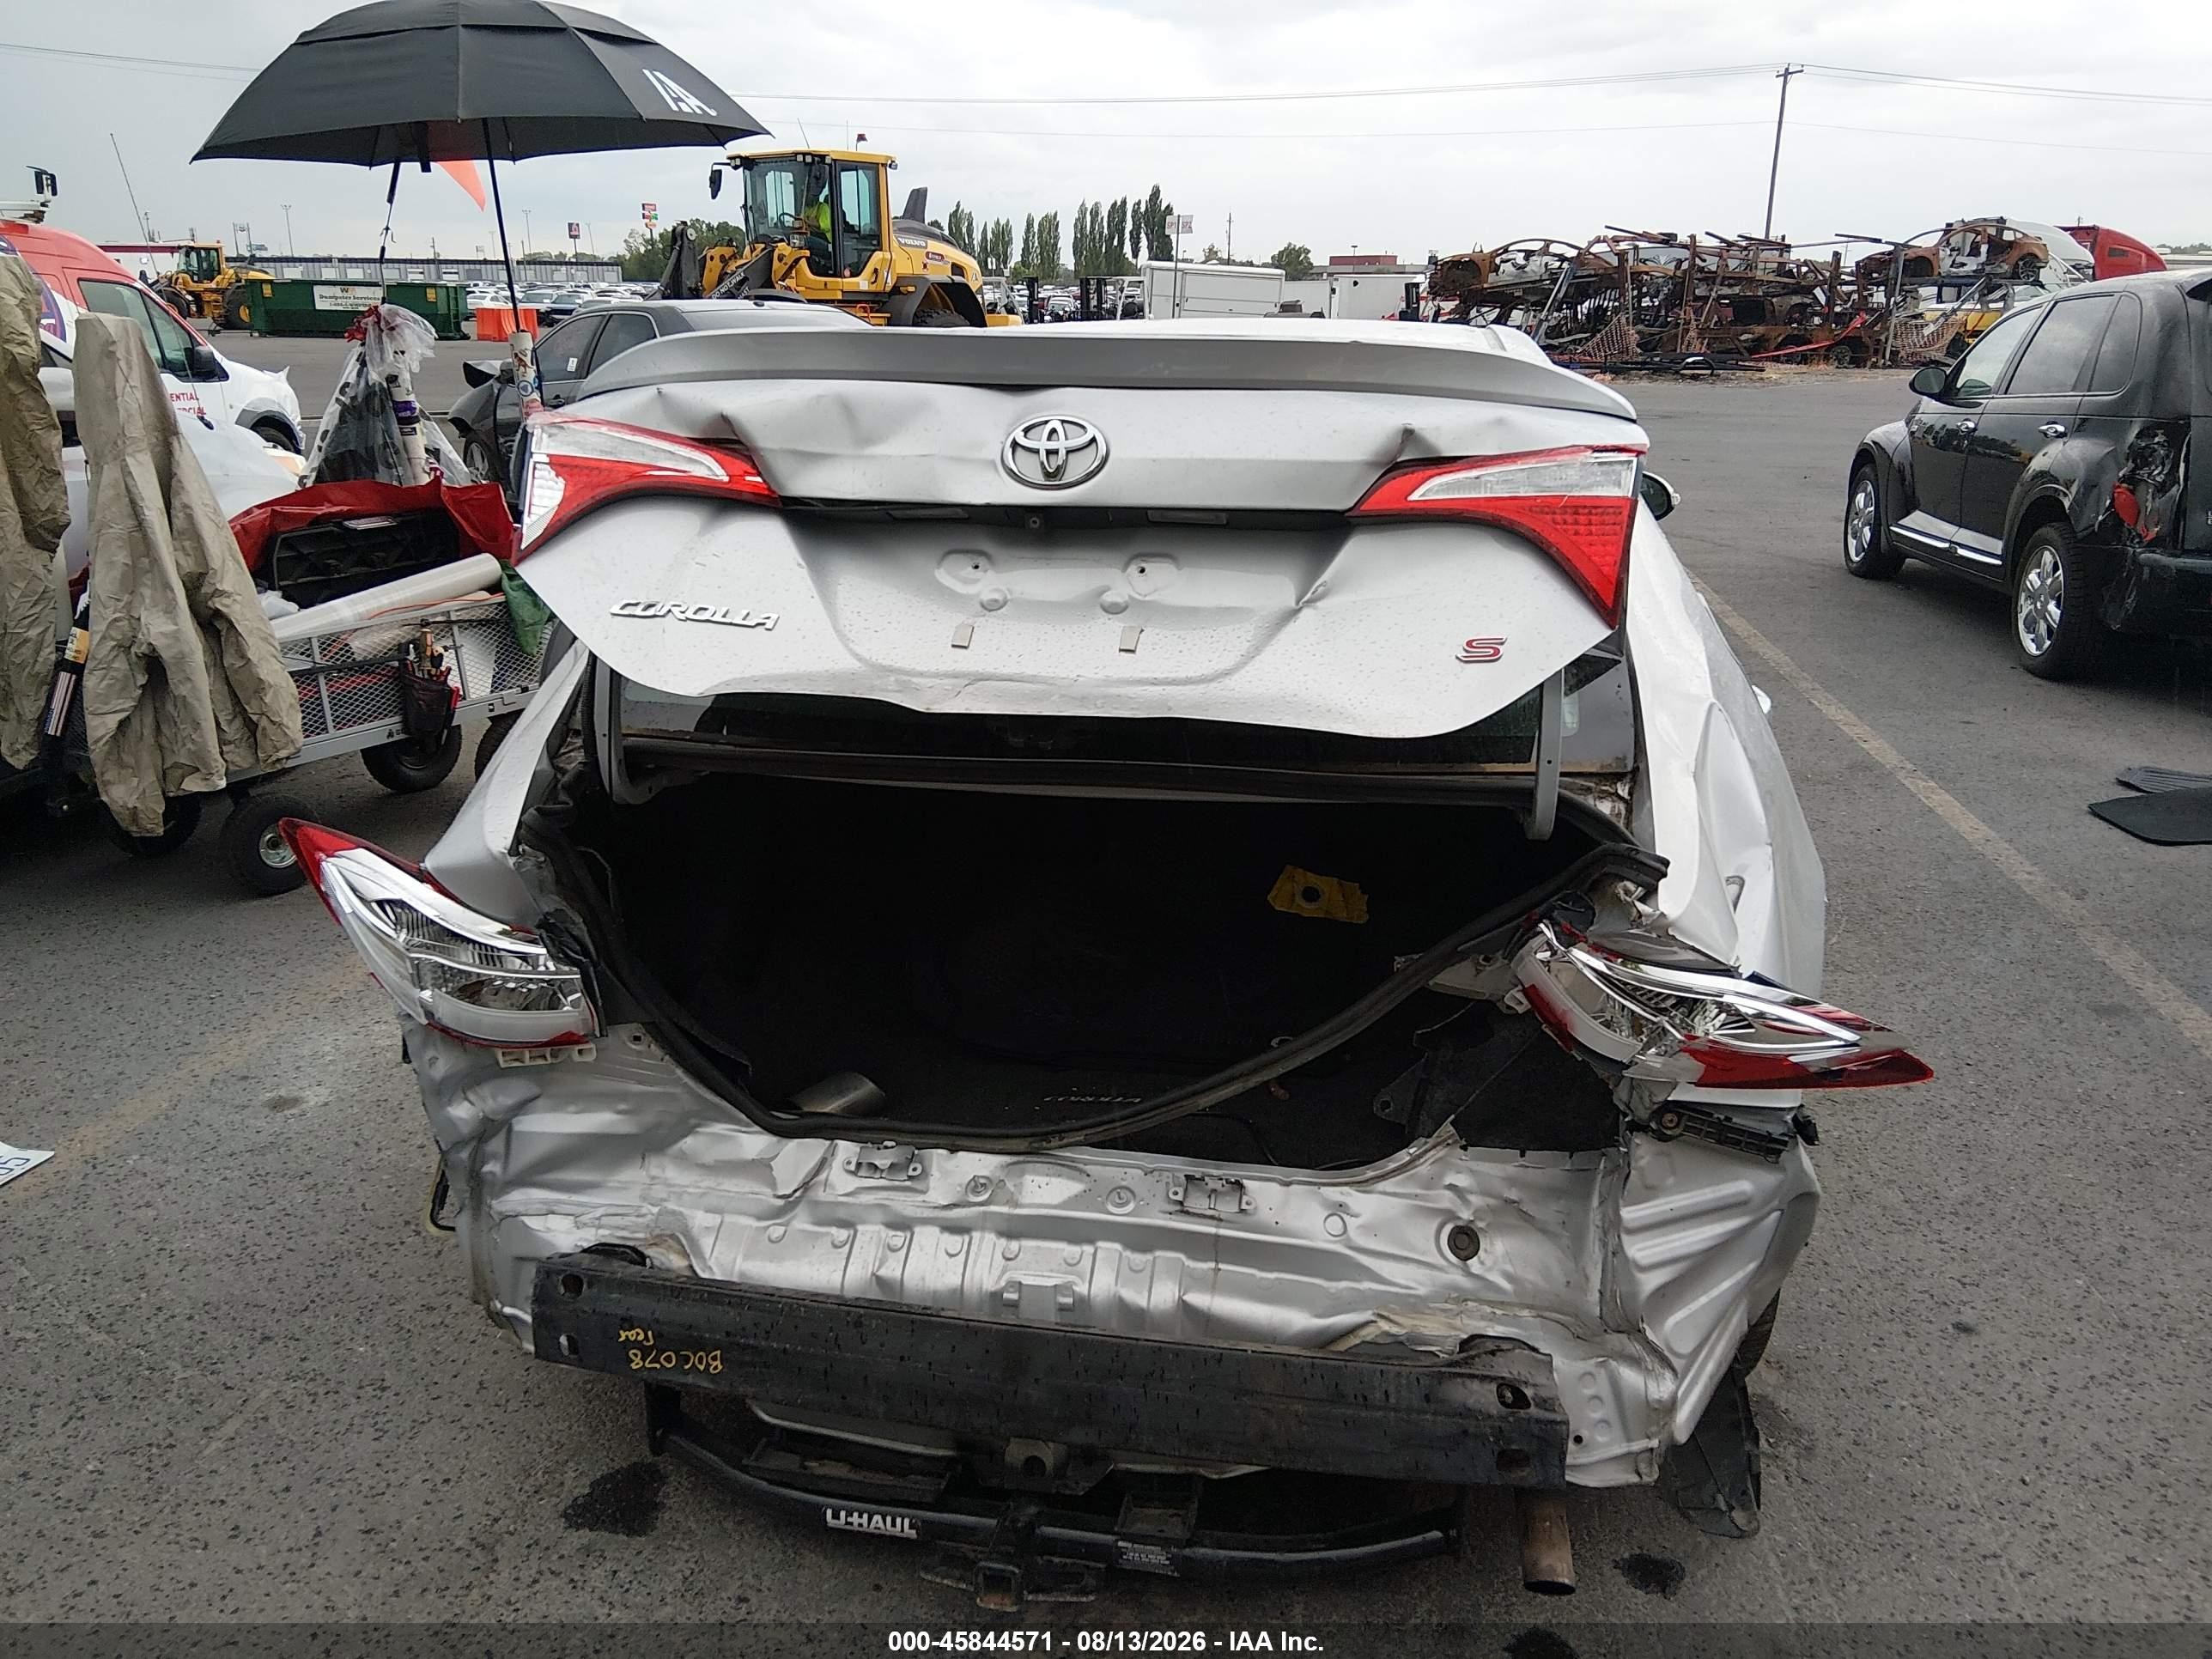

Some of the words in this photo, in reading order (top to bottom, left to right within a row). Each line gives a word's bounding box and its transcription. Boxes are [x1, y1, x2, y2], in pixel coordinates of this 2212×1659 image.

[897, 237, 926, 247] VOLVO
[170, 392, 199, 402] ENTIAL
[611, 600, 780, 631] COROLLA
[1455, 636, 1507, 664] S
[826, 1508, 918, 1540] U-HAUL
